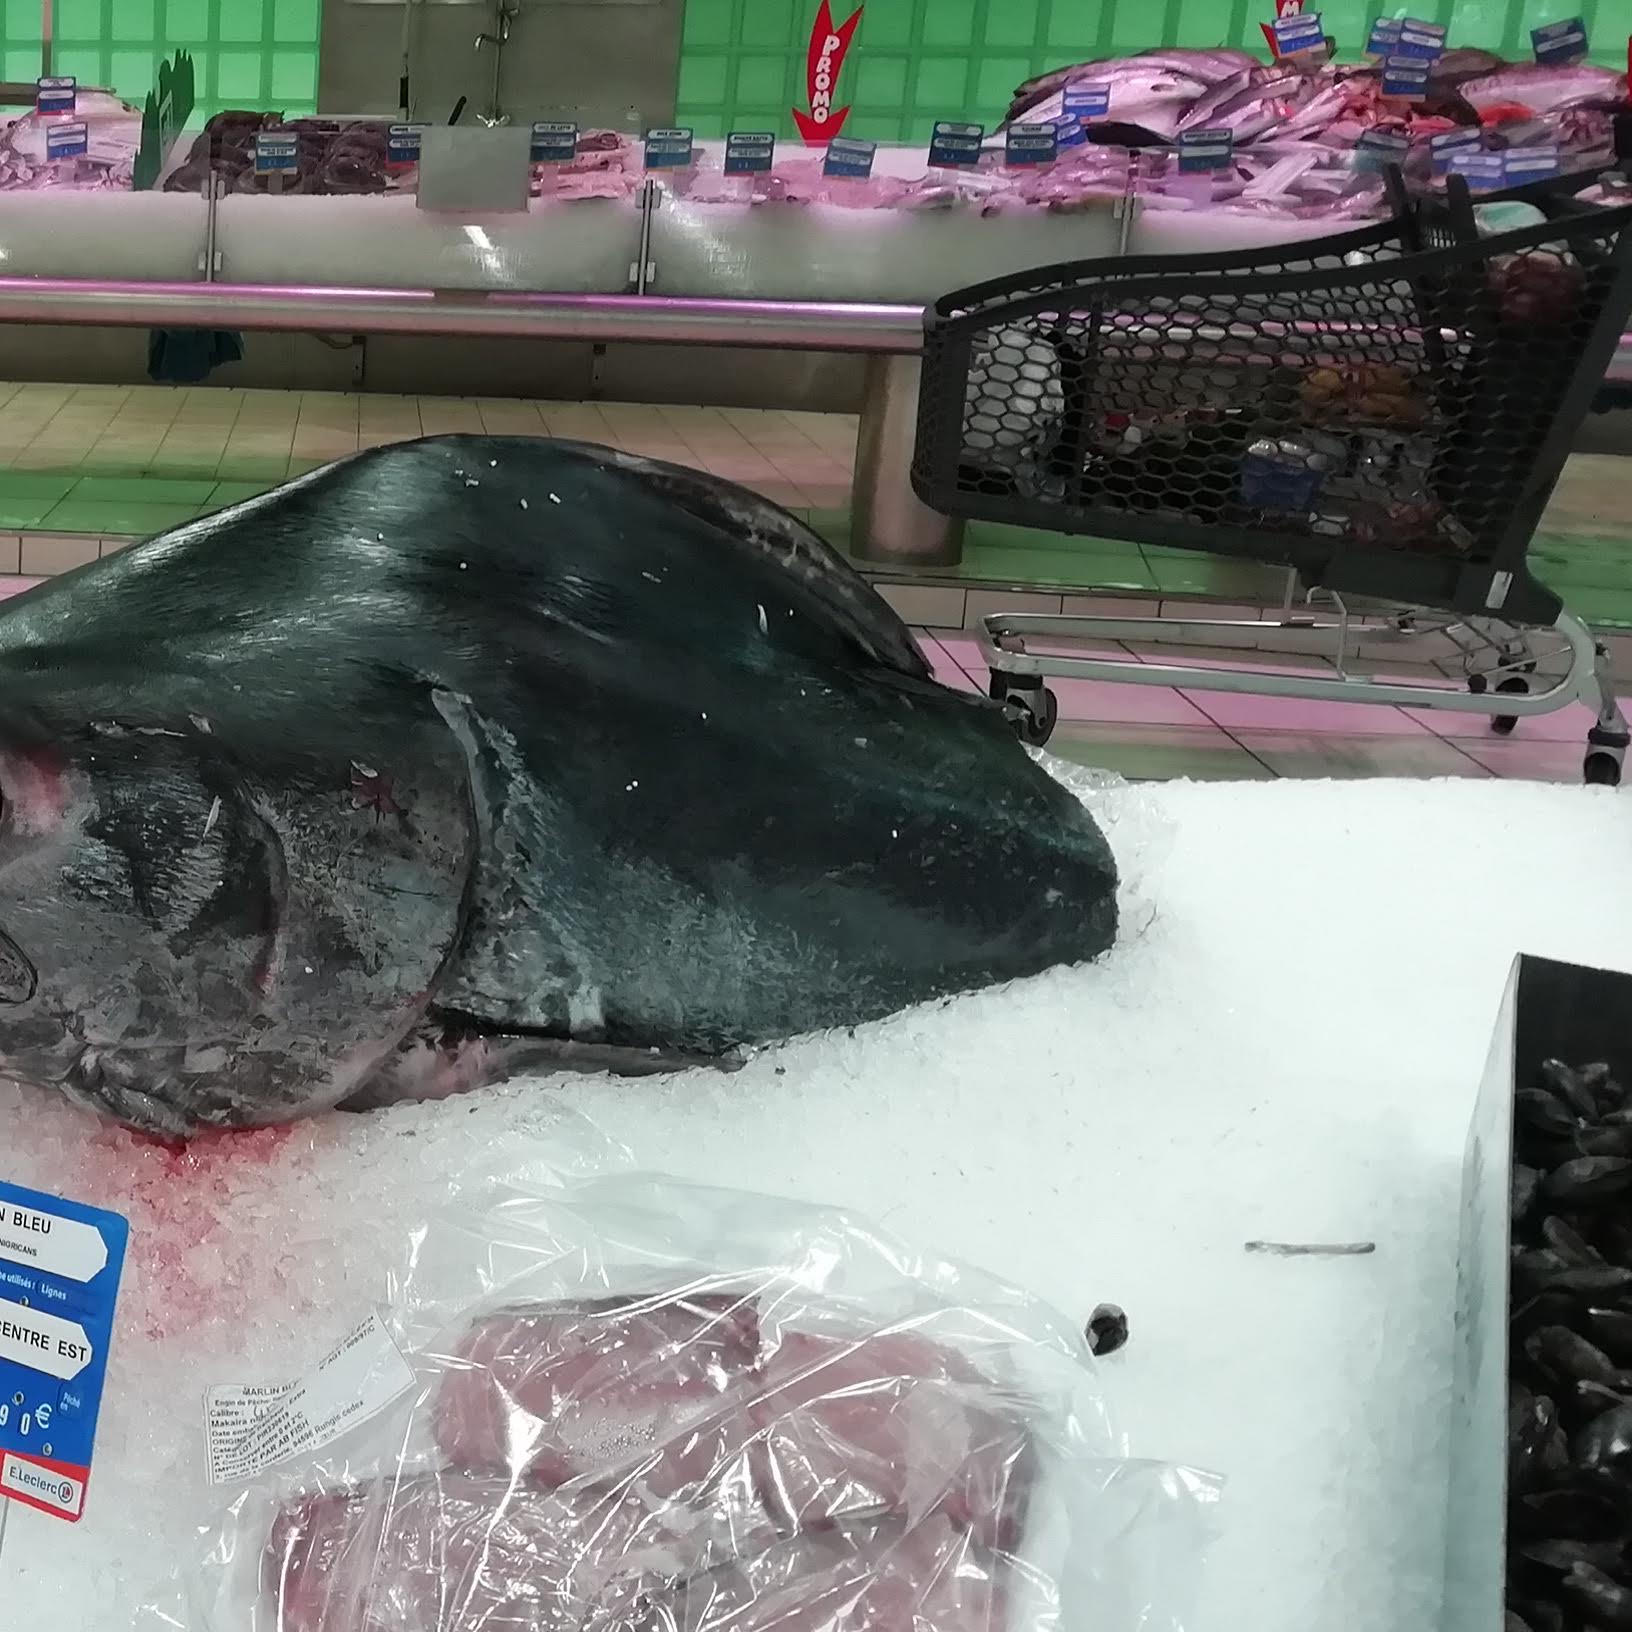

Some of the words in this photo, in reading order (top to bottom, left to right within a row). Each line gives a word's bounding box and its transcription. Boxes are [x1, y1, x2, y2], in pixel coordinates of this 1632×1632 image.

[812, 35, 840, 124] PROMO
[13, 1211, 51, 1234] BLEU
[41, 1283, 66, 1300] Lignes
[57, 1340, 87, 1363] EST
[243, 1387, 279, 1396] MARLIN
[212, 1419, 247, 1428] Makaira
[290, 1419, 309, 1437] FISH
[314, 1414, 341, 1433] Rungis
[9, 1466, 58, 1495] E.Leclerc
